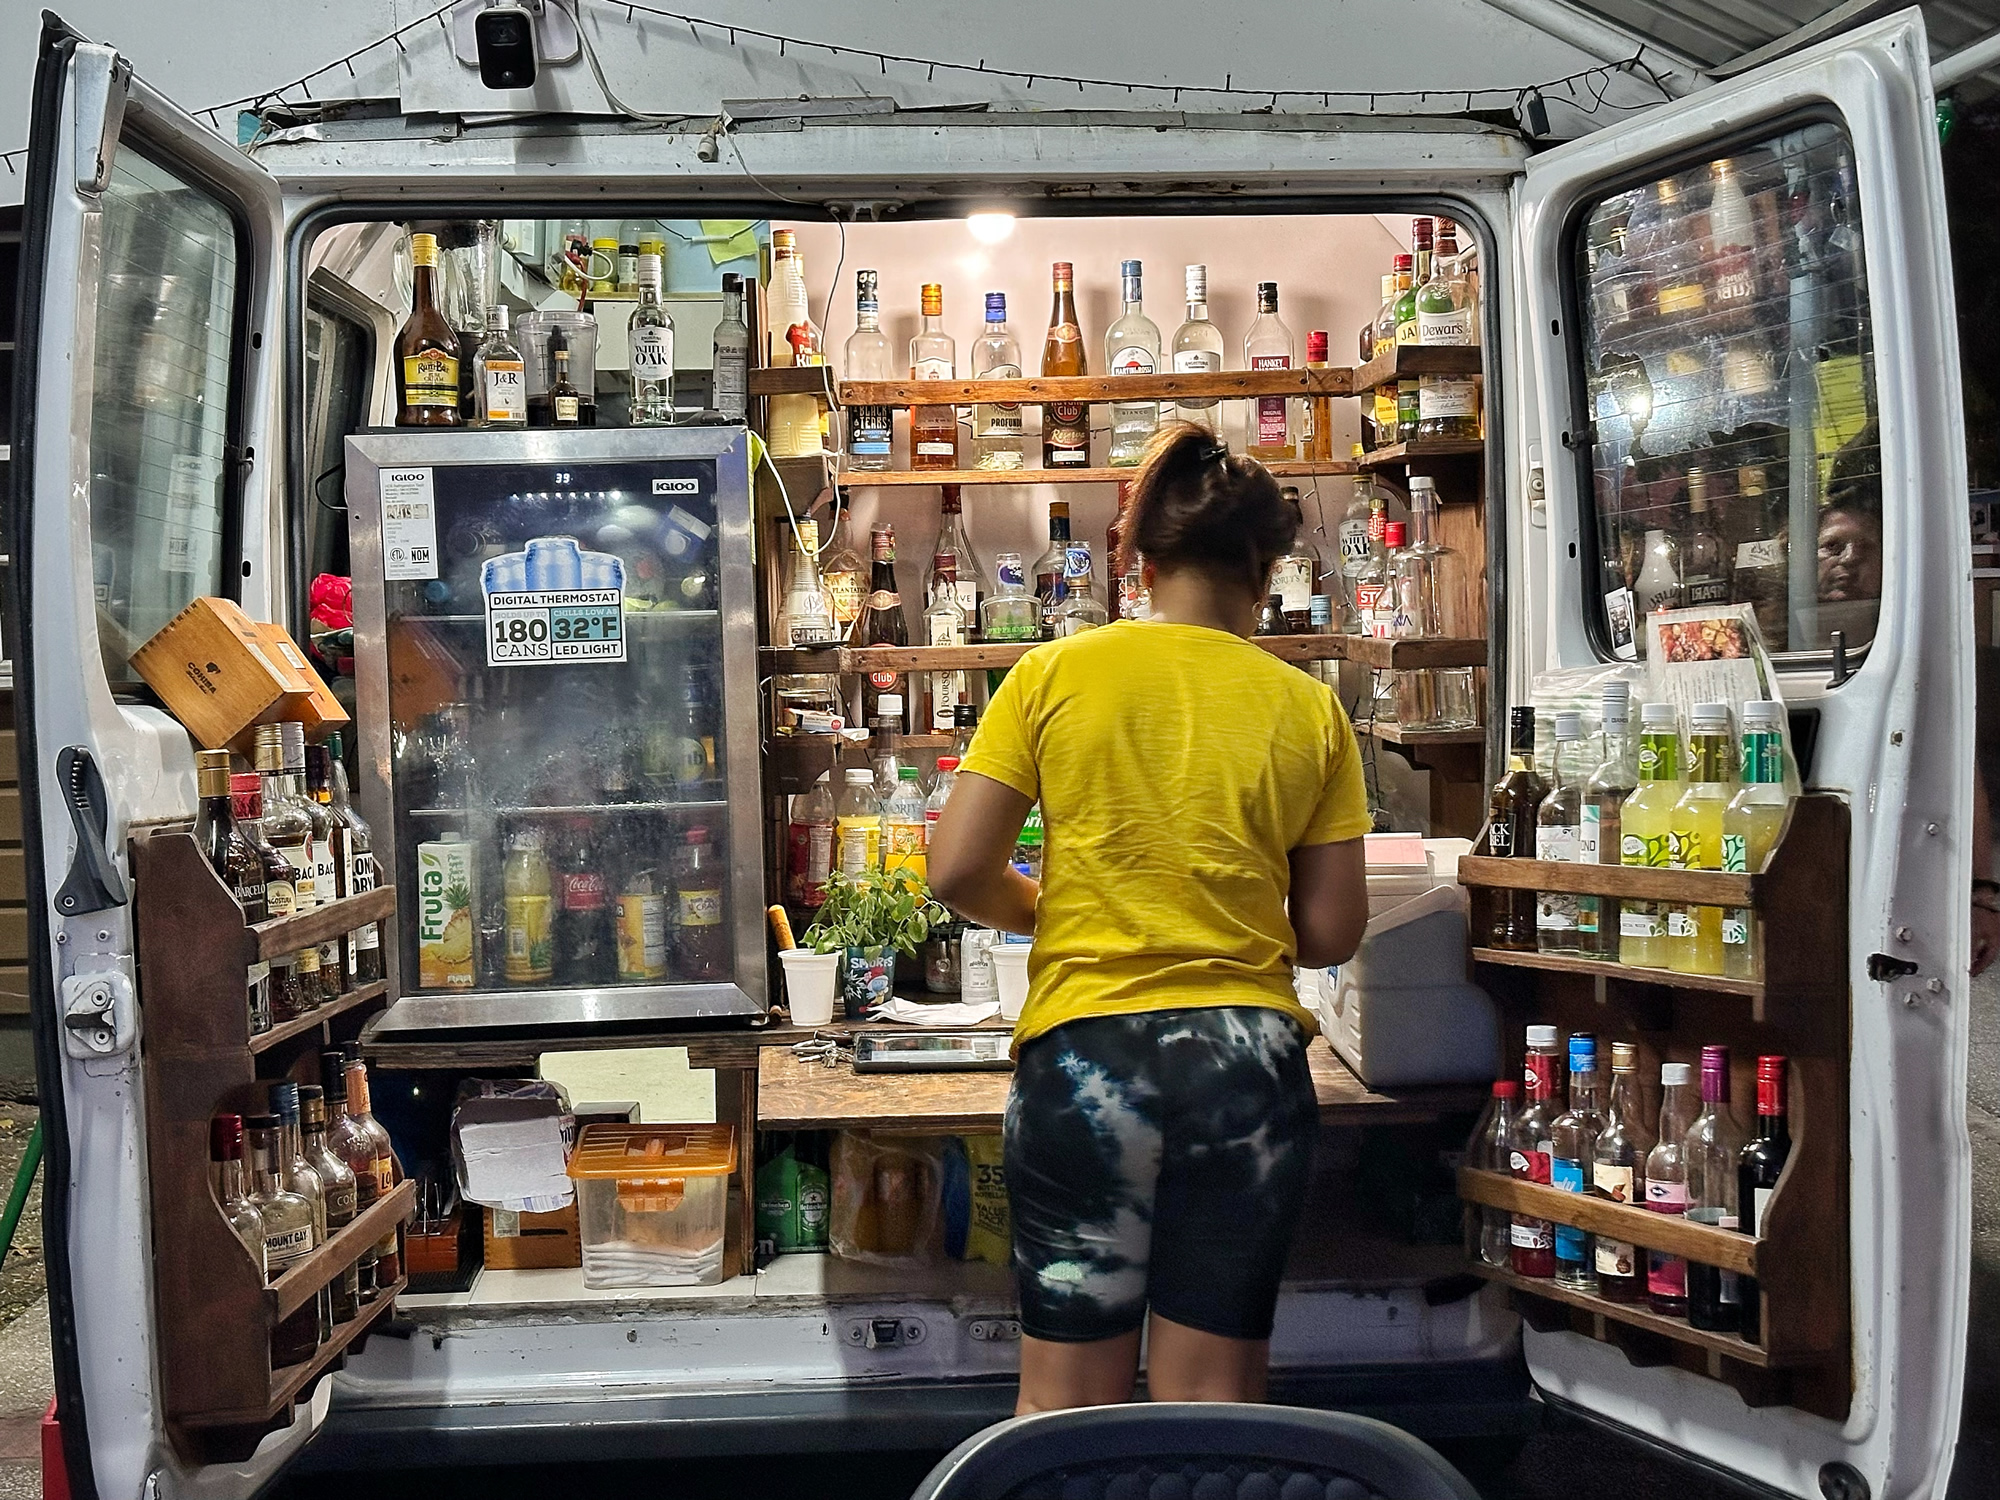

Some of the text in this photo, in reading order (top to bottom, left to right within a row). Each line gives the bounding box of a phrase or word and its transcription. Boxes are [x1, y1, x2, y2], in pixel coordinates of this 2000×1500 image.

[1422, 323, 1464, 337] Dewar's
[635, 353, 667, 365] OAK
[1258, 359, 1284, 369] HANKEY
[494, 372, 518, 387] J&R
[1057, 405, 1078, 416] Club
[859, 416, 888, 429] TEARS
[391, 474, 425, 482] IGLOO
[656, 482, 695, 491] IGLOO
[411, 549, 430, 561] NOM
[493, 593, 616, 606] DIGITAL THERMOSTAT
[553, 609, 584, 617] CHILLS
[585, 608, 604, 616] LOW
[495, 618, 548, 643] 180
[554, 616, 618, 640] 32°F
[496, 643, 549, 658] CANS
[555, 644, 618, 655] LED LIGHT
[872, 673, 893, 683] Club
[420, 869, 444, 942] Fruta
[976, 1163, 1005, 1185] 35
[265, 1230, 308, 1249] MOUNT GAY
